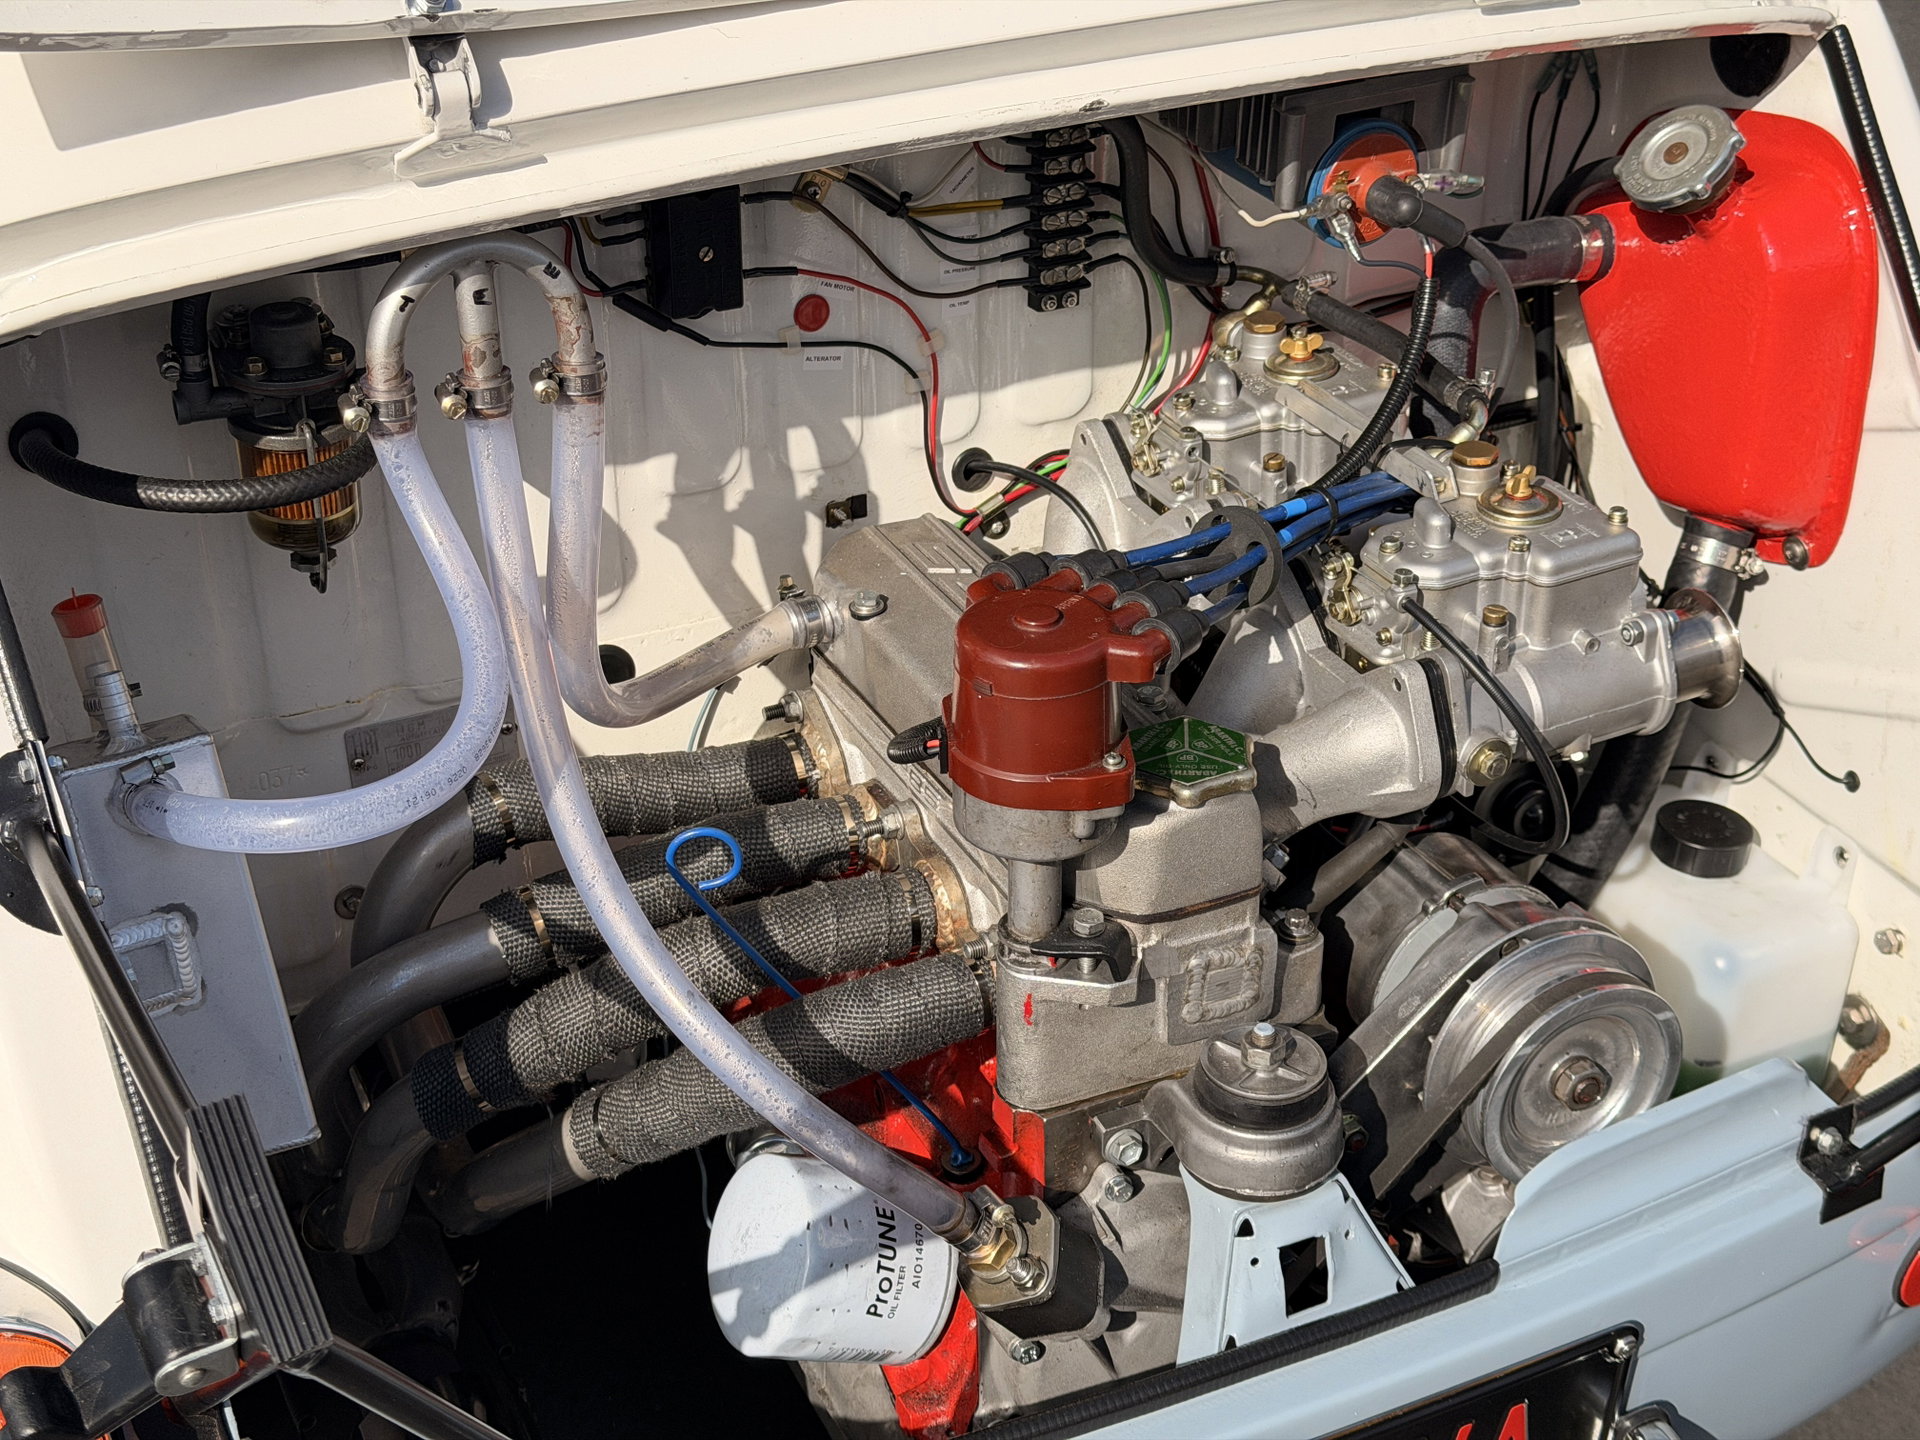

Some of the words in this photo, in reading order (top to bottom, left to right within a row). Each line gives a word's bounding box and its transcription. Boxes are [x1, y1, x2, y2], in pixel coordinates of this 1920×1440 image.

[820, 280, 833, 289] FAN
[833, 283, 856, 292] MOTOR
[865, 1206, 896, 1318] ProTUNE
[887, 1303, 899, 1320] OIL
[893, 1265, 907, 1301] FILTER
